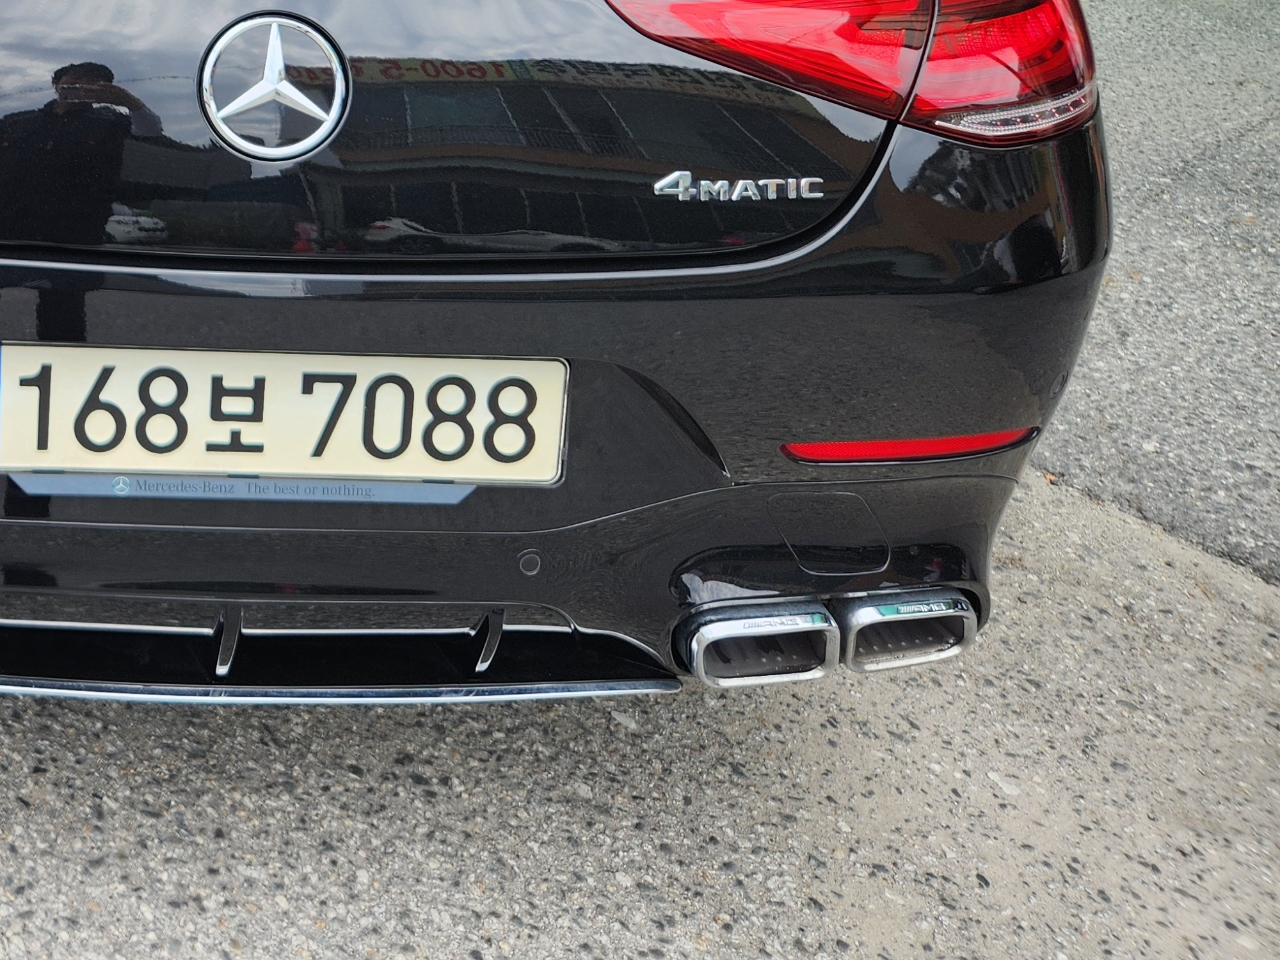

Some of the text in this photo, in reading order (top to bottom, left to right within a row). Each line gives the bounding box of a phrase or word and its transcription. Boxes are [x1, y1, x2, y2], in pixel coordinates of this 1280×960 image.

[653, 170, 825, 202] 4MATIC
[135, 478, 376, 499] Mercedes-Benz The best or nothing.
